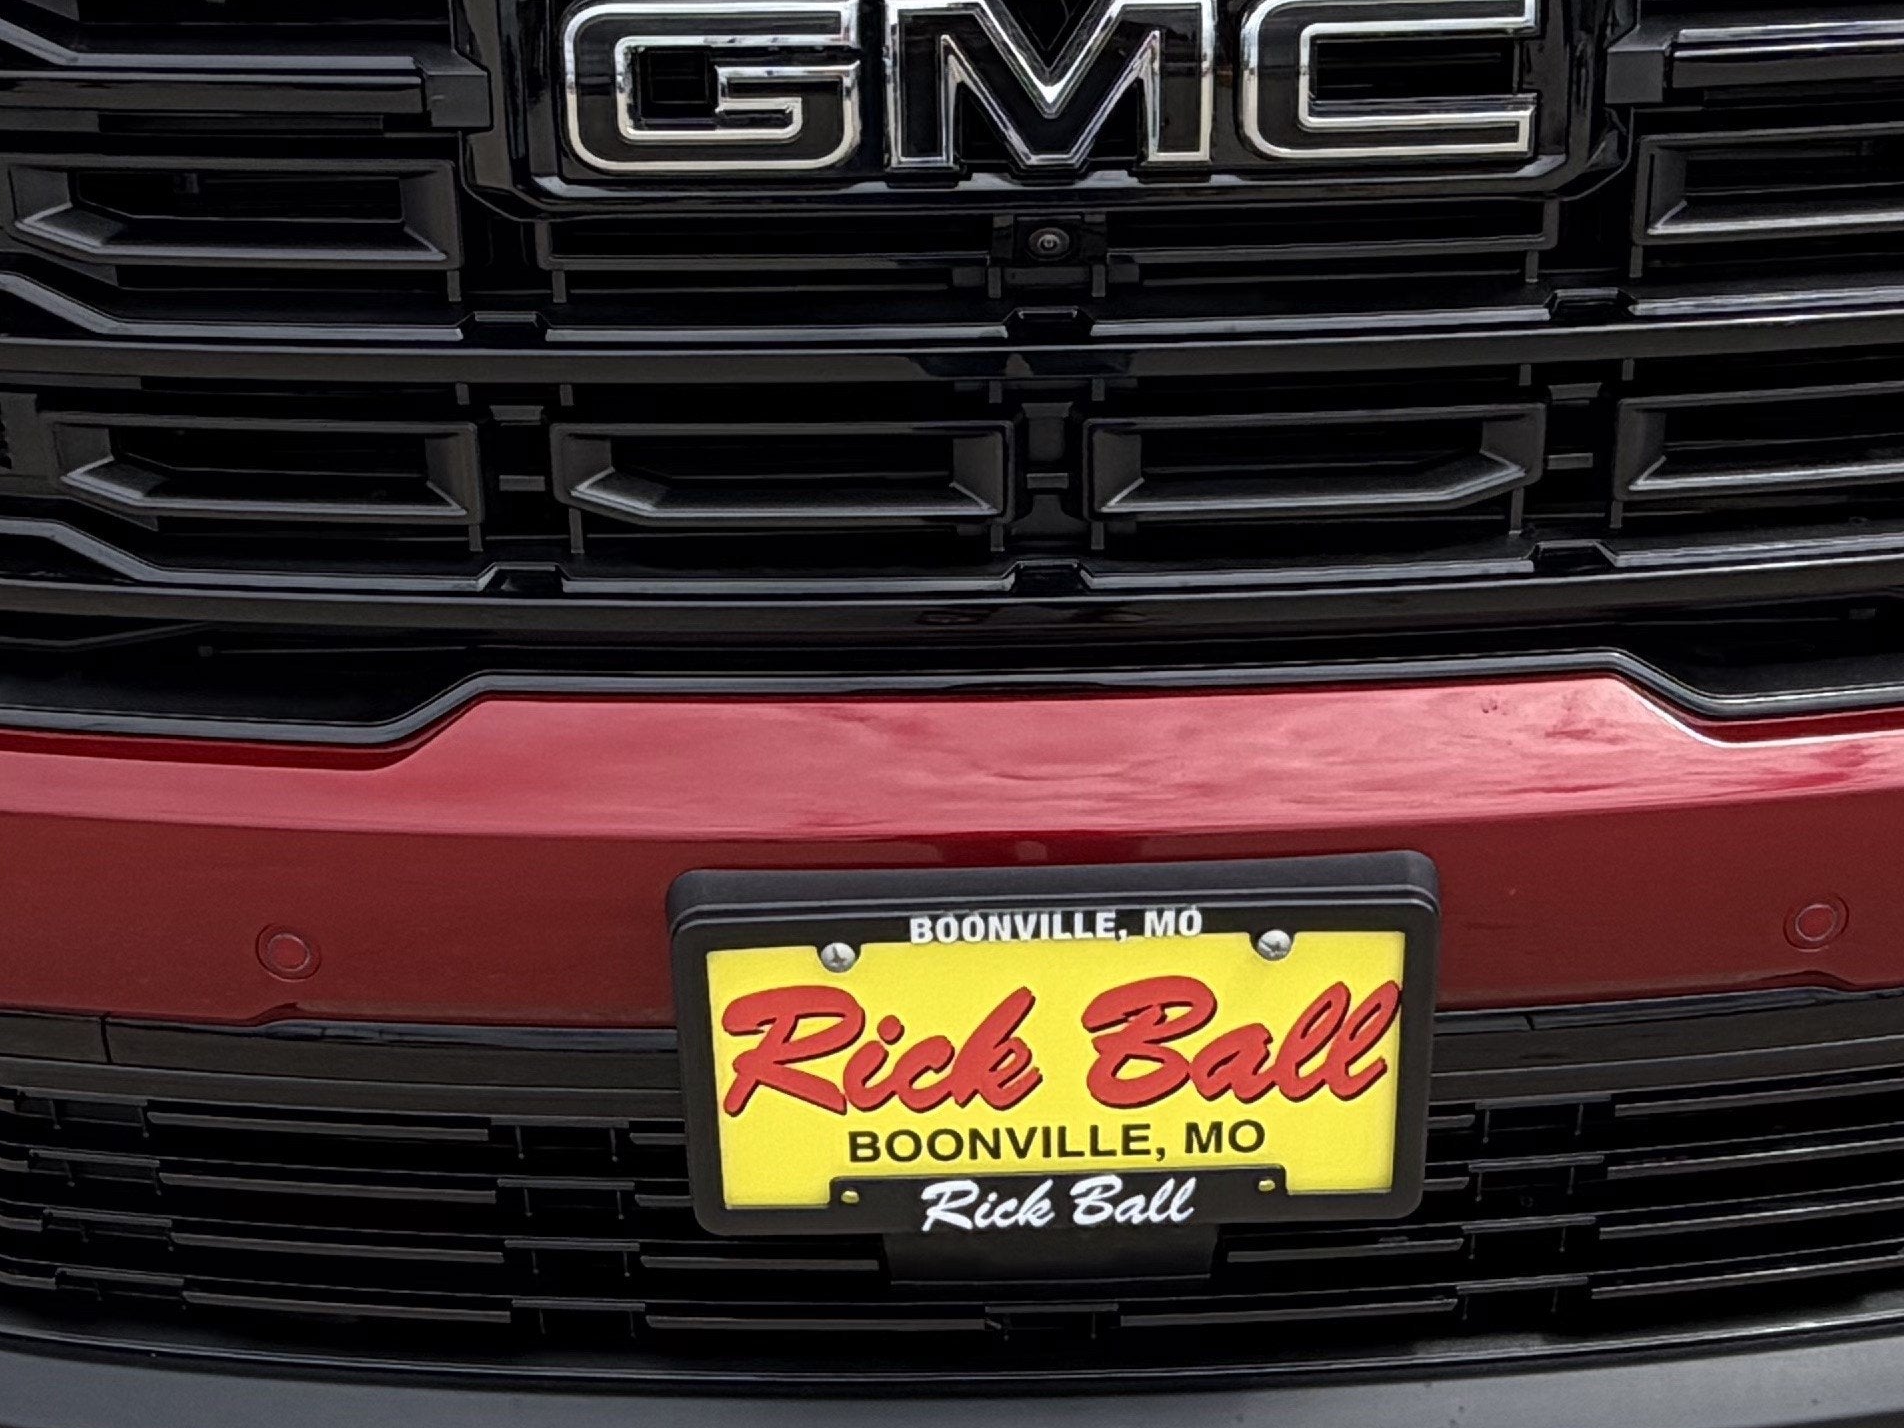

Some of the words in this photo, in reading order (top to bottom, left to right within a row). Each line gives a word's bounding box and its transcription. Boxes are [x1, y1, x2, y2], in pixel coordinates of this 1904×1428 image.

[908, 910, 1131, 945] BOONVILLE,
[1143, 906, 1204, 938] MO
[721, 983, 1044, 1119] Rick
[1081, 974, 1404, 1112] Ball
[847, 1123, 1168, 1165] BOONVILLE,
[1183, 1119, 1269, 1155] MO
[920, 1180, 1057, 1233] Rick
[1072, 1176, 1198, 1228] Ball
